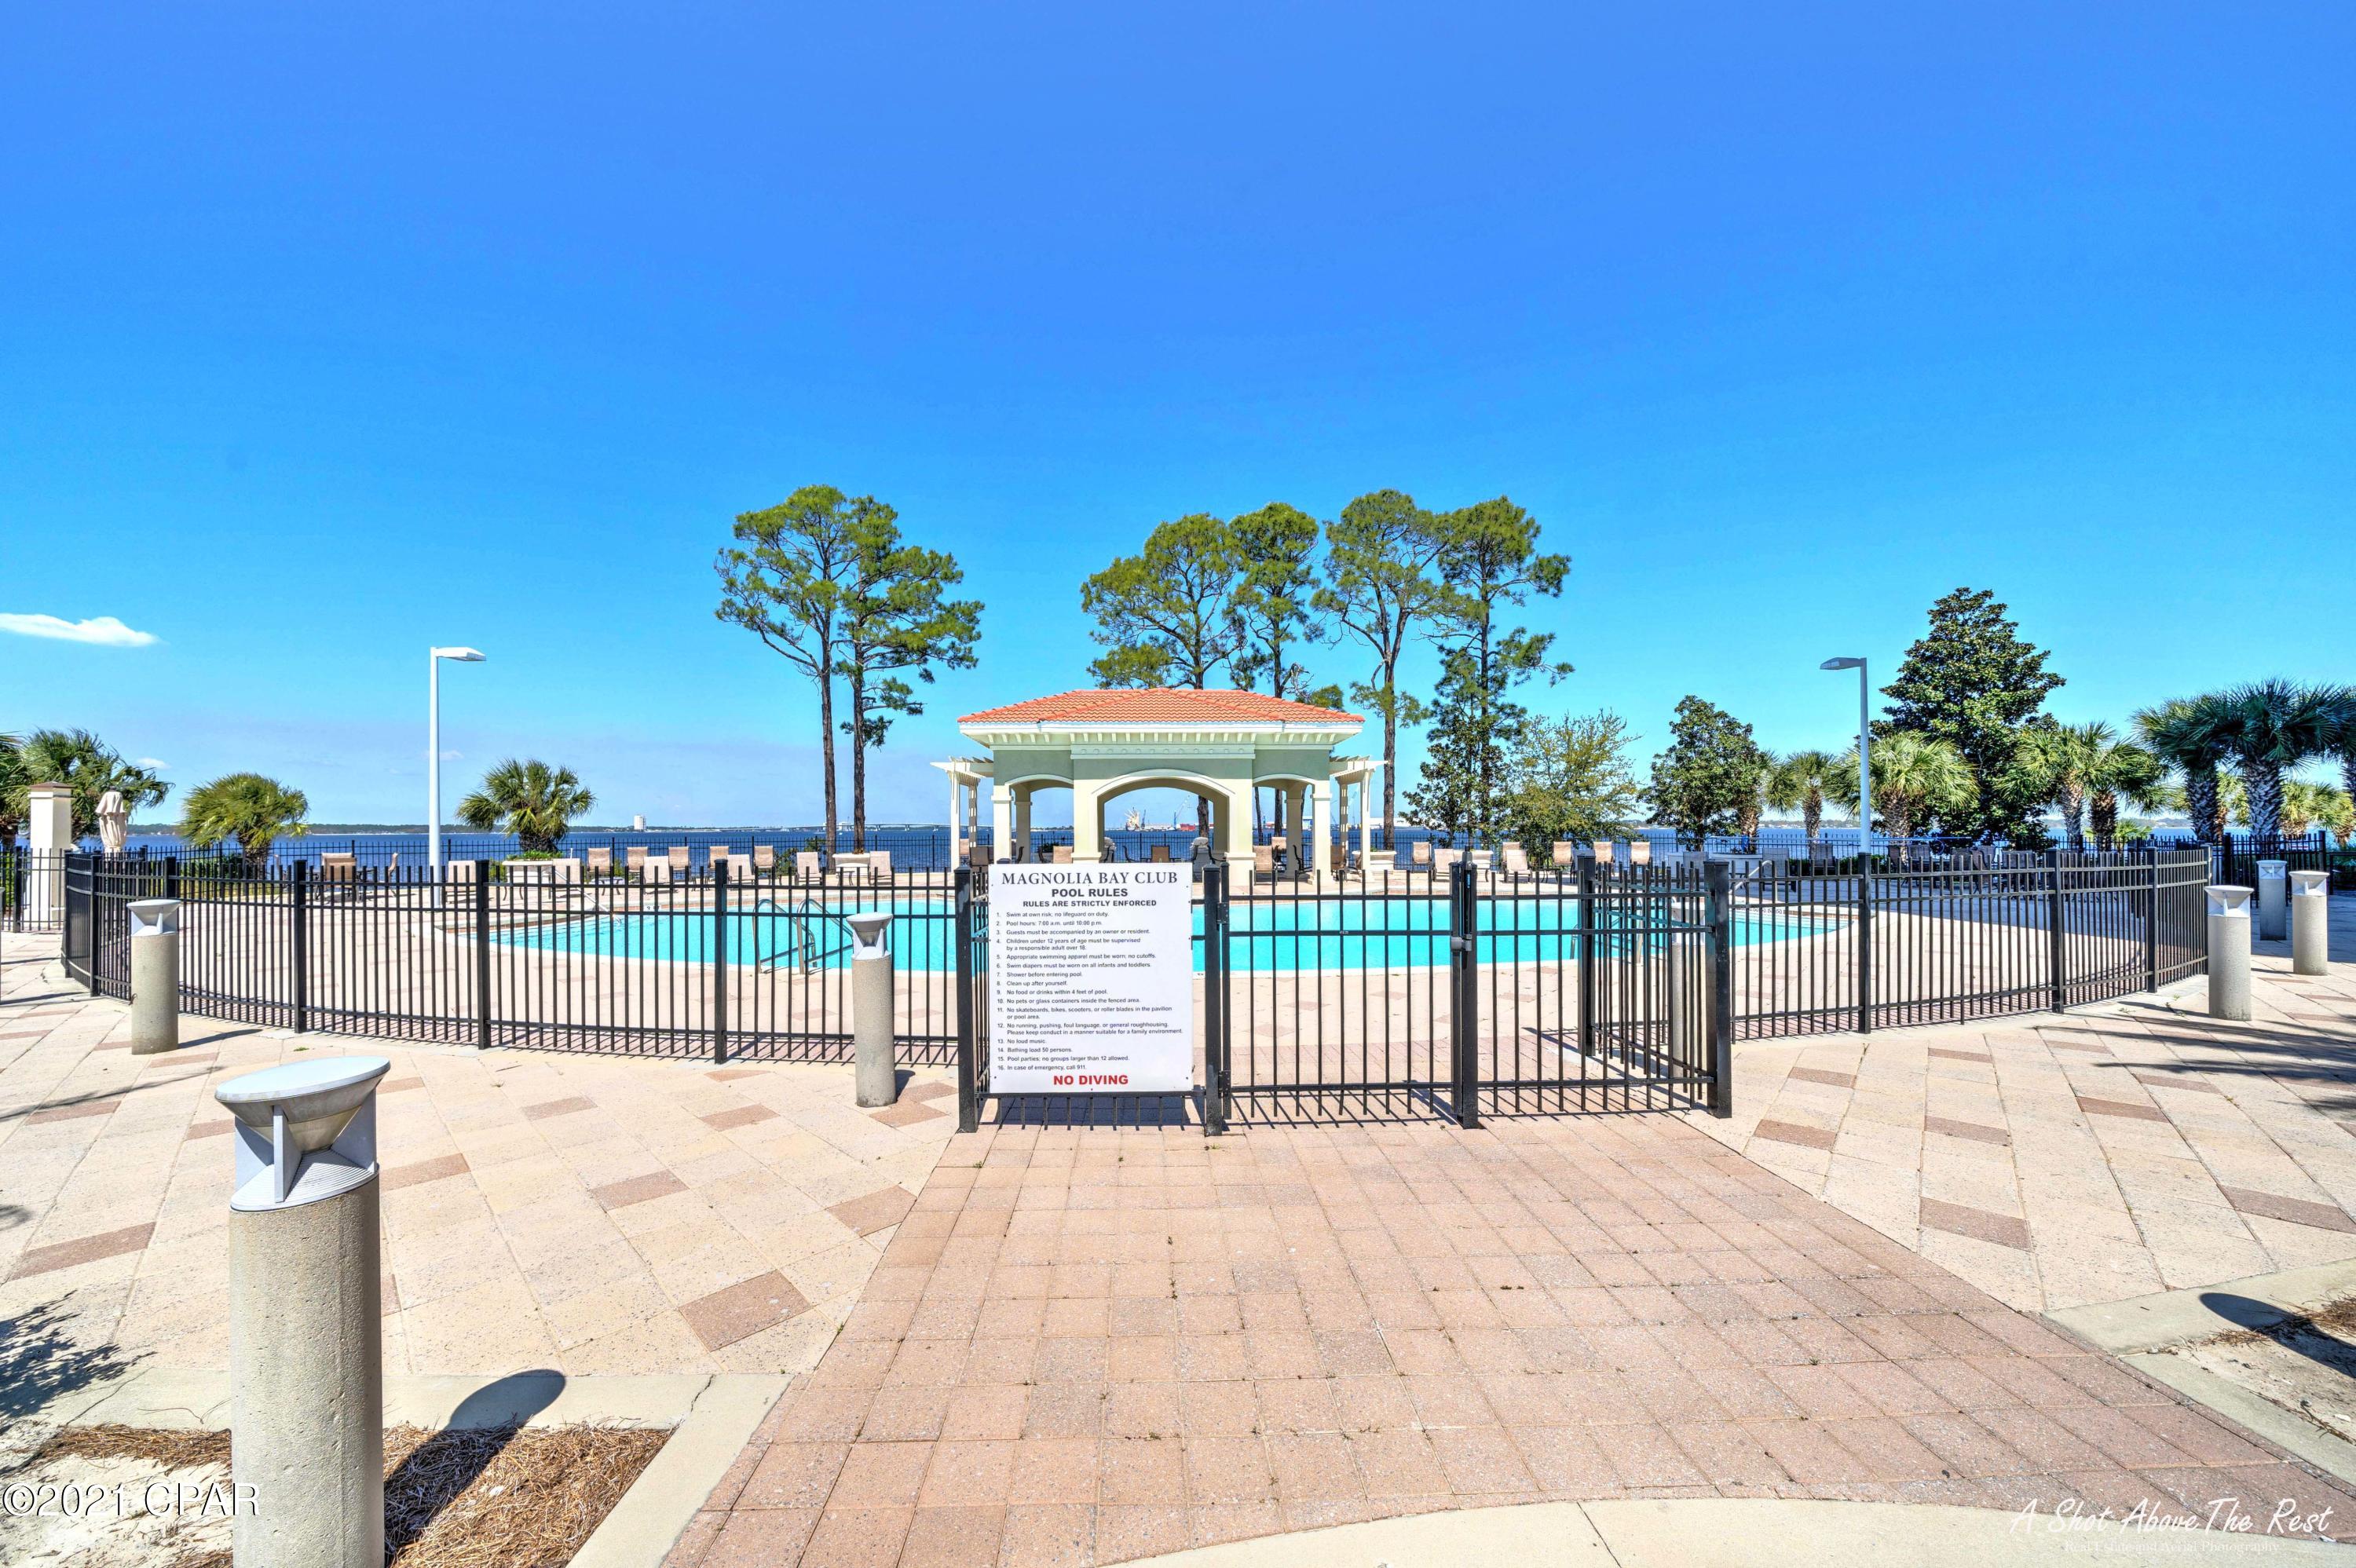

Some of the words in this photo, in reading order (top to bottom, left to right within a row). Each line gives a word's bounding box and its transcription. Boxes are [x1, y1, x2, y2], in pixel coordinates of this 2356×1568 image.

[1002, 873, 1093, 884] MAGNOLIA
[1099, 872, 1129, 884] BAY
[1134, 872, 1177, 883] CLUB
[1088, 888, 1129, 897] RULES
[1053, 1075, 1074, 1085] NO
[1078, 1075, 1129, 1084] DIVING
